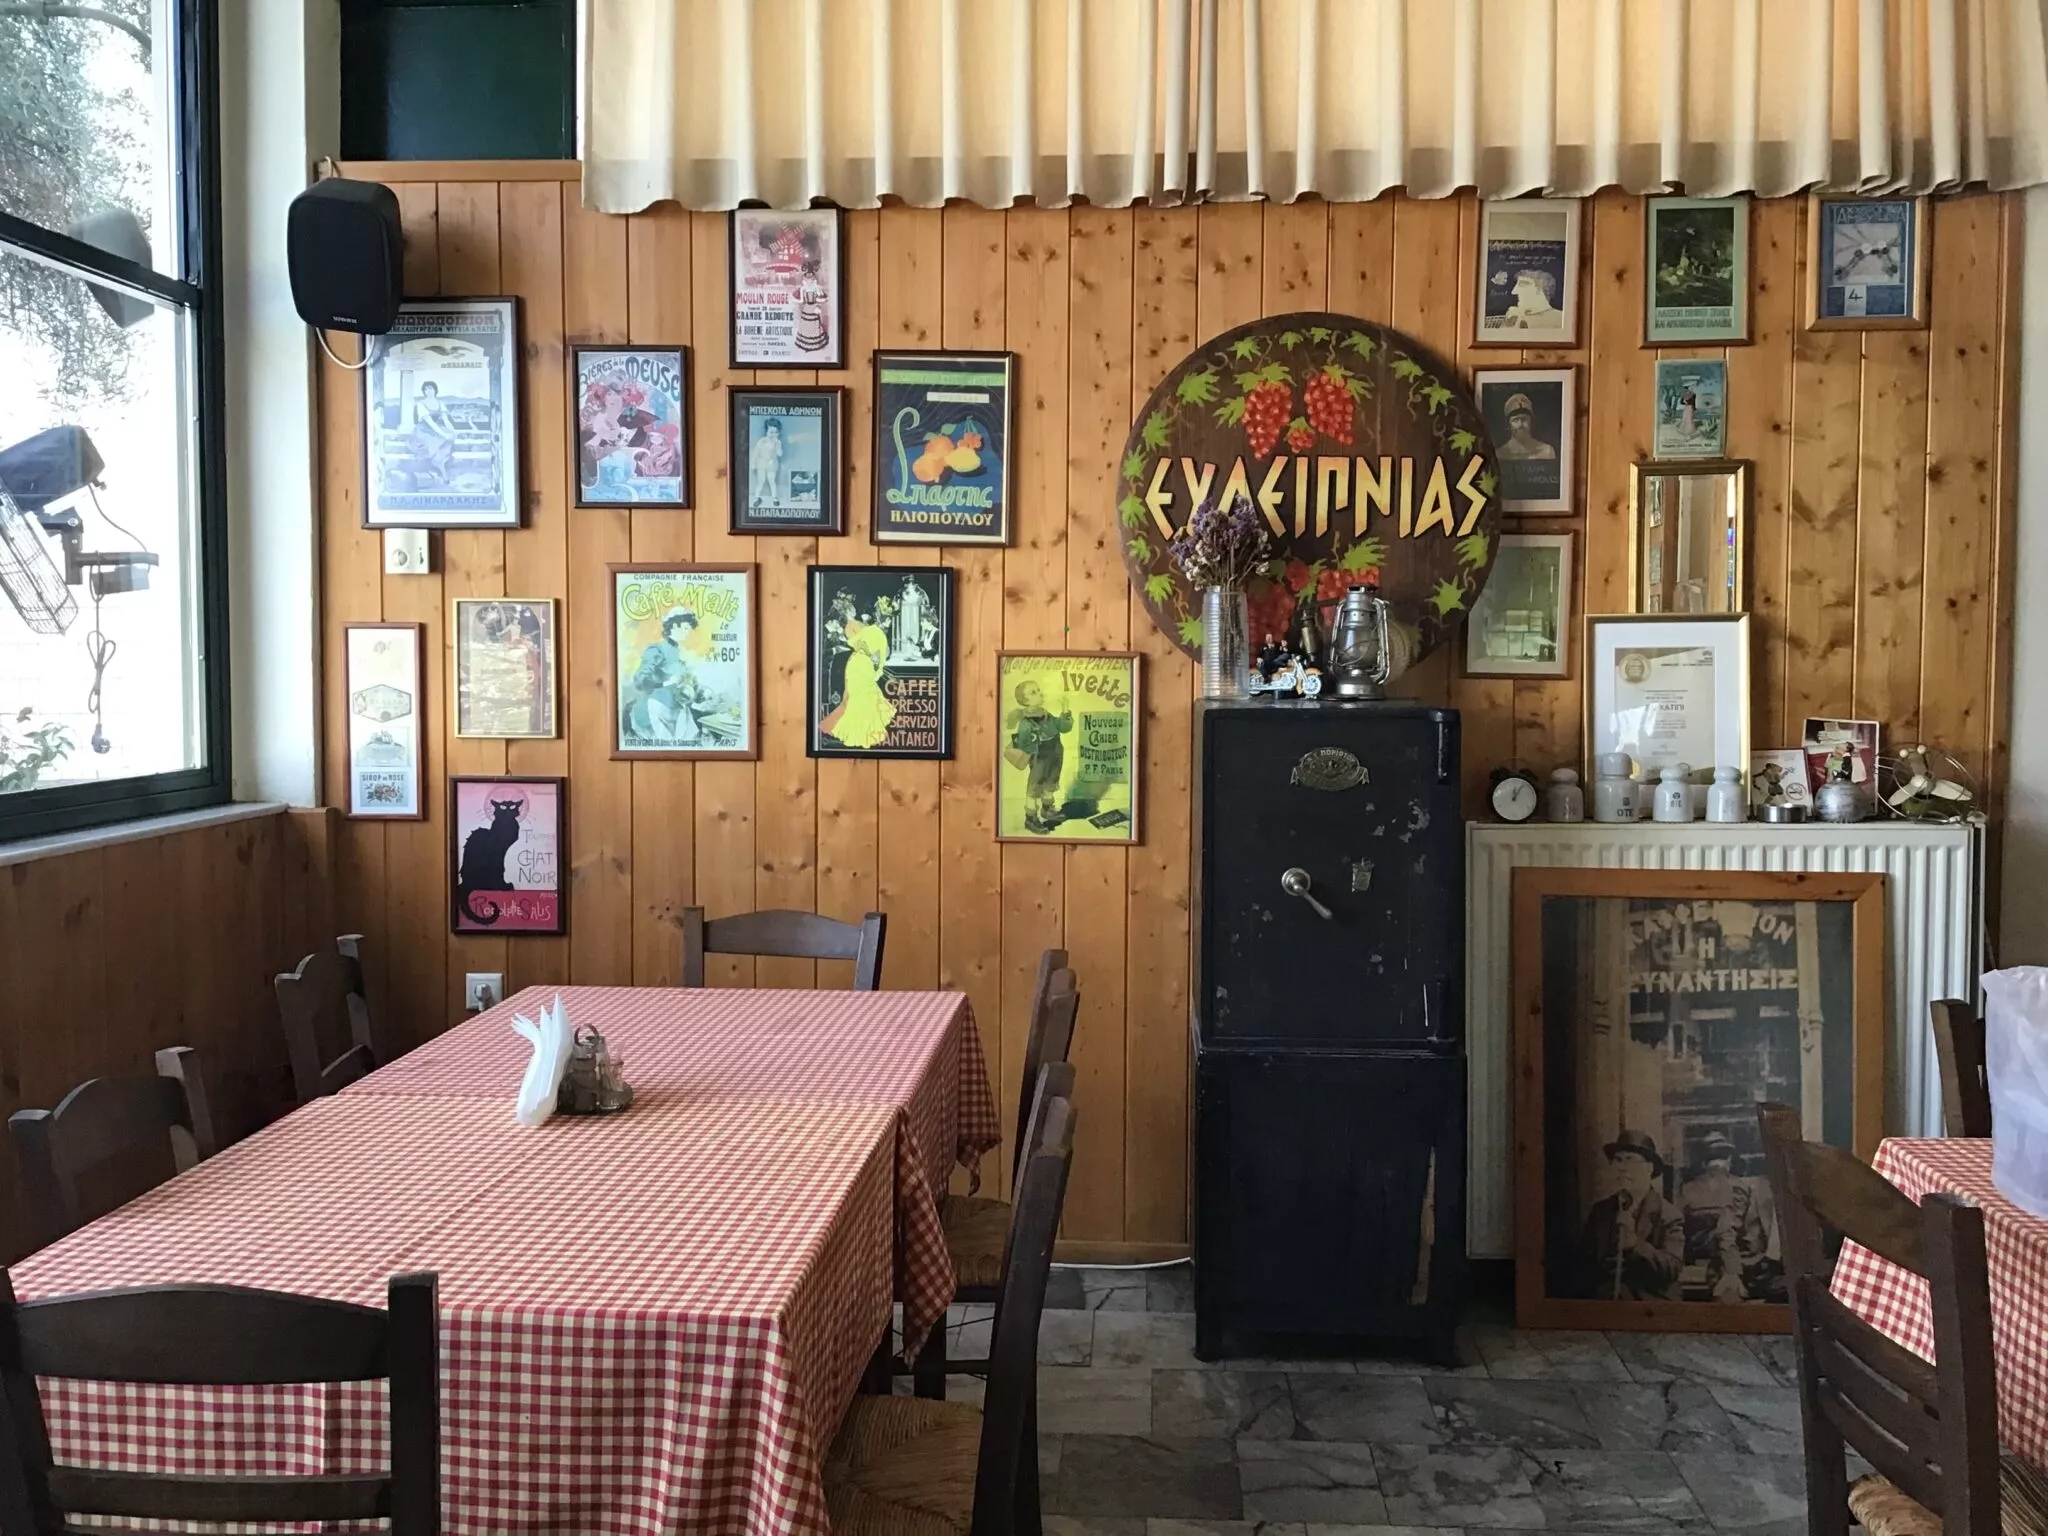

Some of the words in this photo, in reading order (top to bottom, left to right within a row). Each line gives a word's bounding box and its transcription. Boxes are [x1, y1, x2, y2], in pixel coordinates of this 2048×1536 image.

[736, 292, 764, 304] MOULIN
[767, 293, 789, 305] ROUGE
[1848, 289, 1863, 301] 4
[735, 311, 762, 320] GRANDE
[625, 356, 681, 402] MEUSE
[789, 406, 822, 416] ΑΘΗΝΩΝ
[890, 510, 994, 527] ΗΛΙΟΠΟΥΛΟΥ
[634, 573, 677, 581] COMPAGNIE
[682, 574, 725, 582] FRANÇAISE
[621, 581, 674, 621] Café
[678, 582, 740, 622] Malt
[1061, 670, 1131, 708] Ivette
[891, 698, 937, 713] PRESSO
[890, 715, 938, 728] SERVIZIO
[361, 774, 382, 782] SIROP
[388, 774, 405, 782] ROSE
[517, 849, 553, 868] CHAT
[518, 867, 558, 886] NOIR
[1699, 937, 1716, 959] Η
